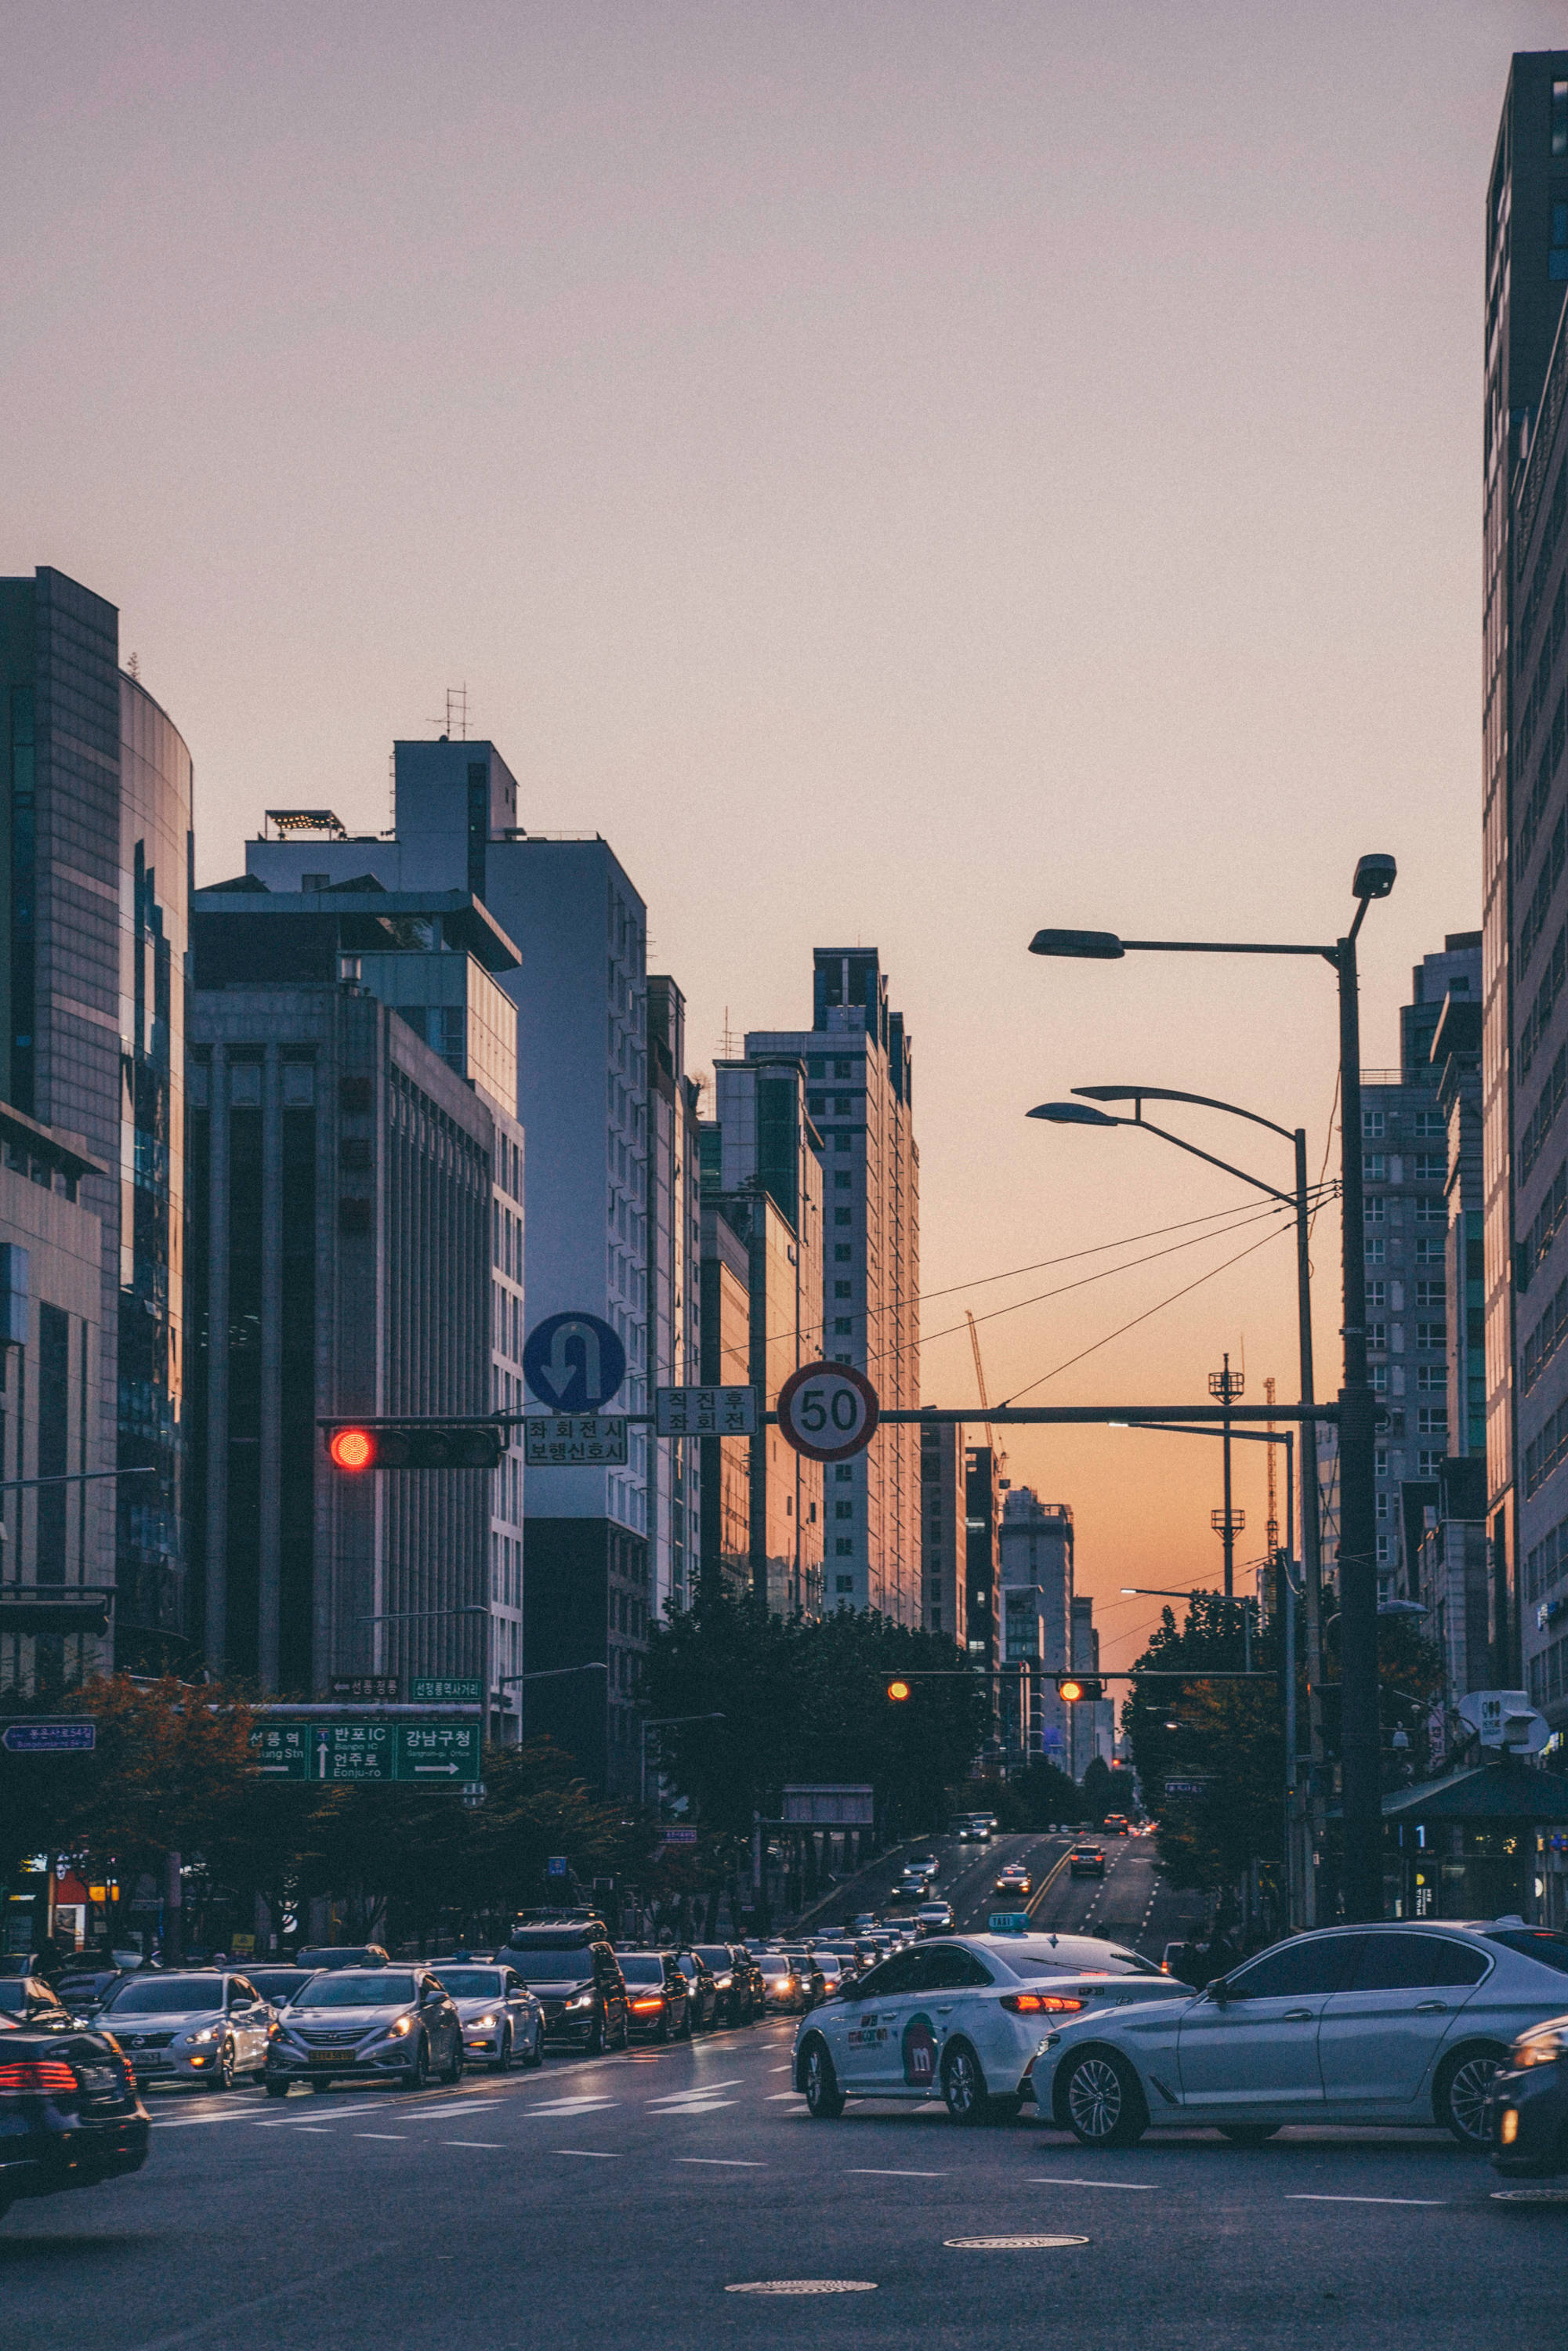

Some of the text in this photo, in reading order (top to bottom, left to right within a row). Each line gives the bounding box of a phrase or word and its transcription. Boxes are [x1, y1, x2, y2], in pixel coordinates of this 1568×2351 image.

[800, 1389, 857, 1433] 50
[670, 1411, 745, 1431] 좌회전
[530, 1443, 622, 1461] 보행신호시
[407, 1730, 470, 1747] 강남구청
[284, 1748, 304, 1759] Stn
[334, 1752, 378, 1767] 언주로
[333, 1768, 382, 1779] Eonju-ro
[992, 1917, 1010, 1925] TAXI
[912, 2048, 931, 2071] m
